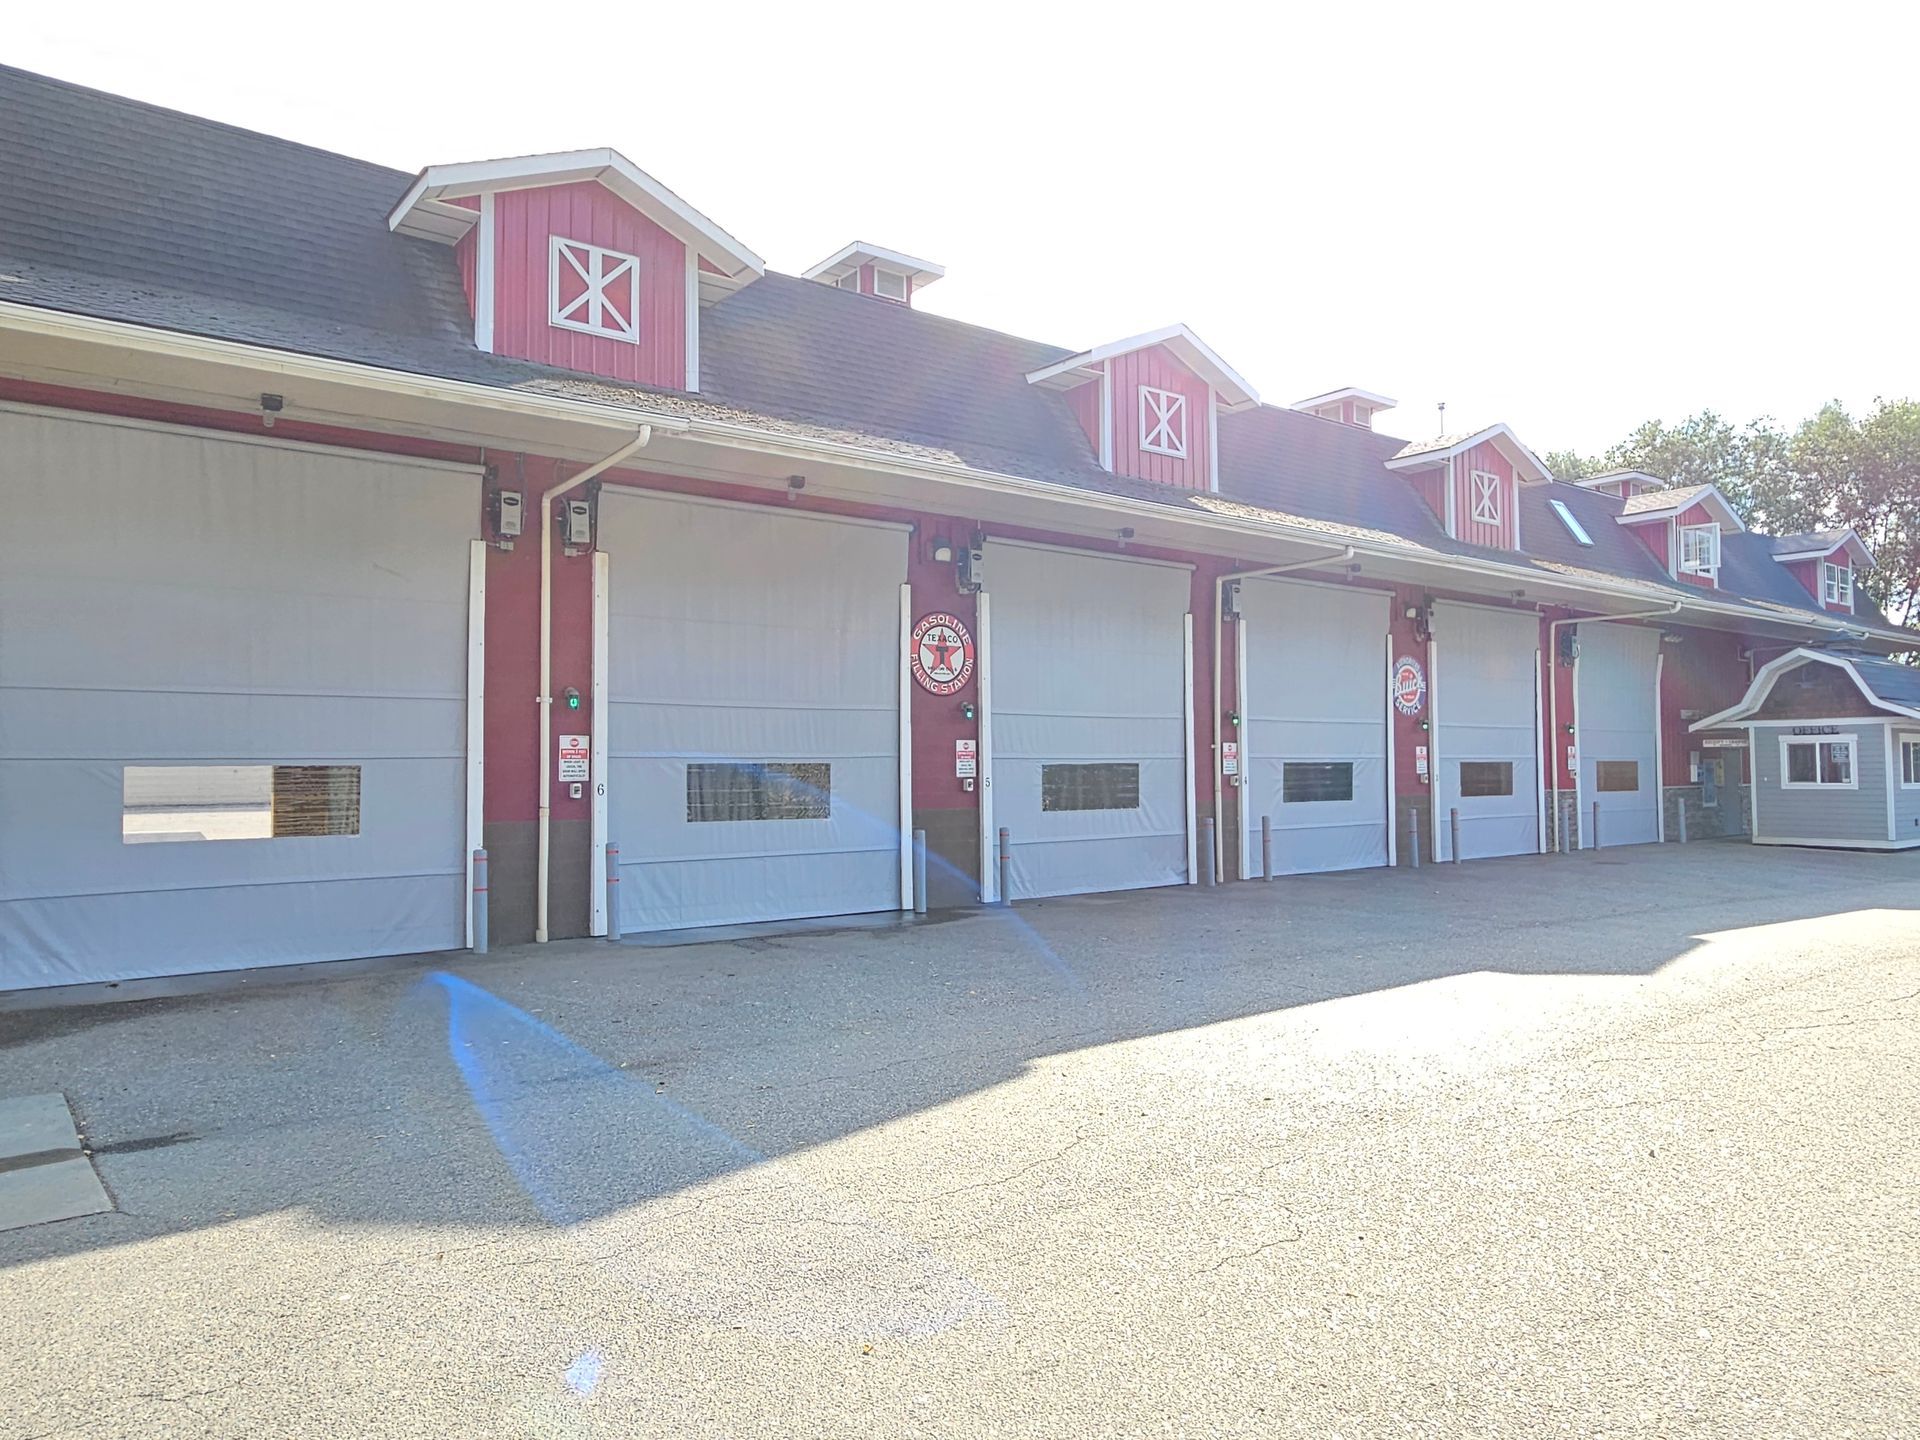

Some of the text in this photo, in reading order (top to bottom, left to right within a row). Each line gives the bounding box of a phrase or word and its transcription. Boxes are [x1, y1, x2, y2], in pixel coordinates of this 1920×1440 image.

[913, 615, 971, 646] GASOLINE
[927, 633, 959, 643] TEXACO
[911, 653, 973, 693] FILLING STATION
[1395, 699, 1421, 715] SERVICE
[1792, 725, 1840, 736] OFFICE
[985, 777, 991, 787] 5
[597, 783, 605, 796] 6
